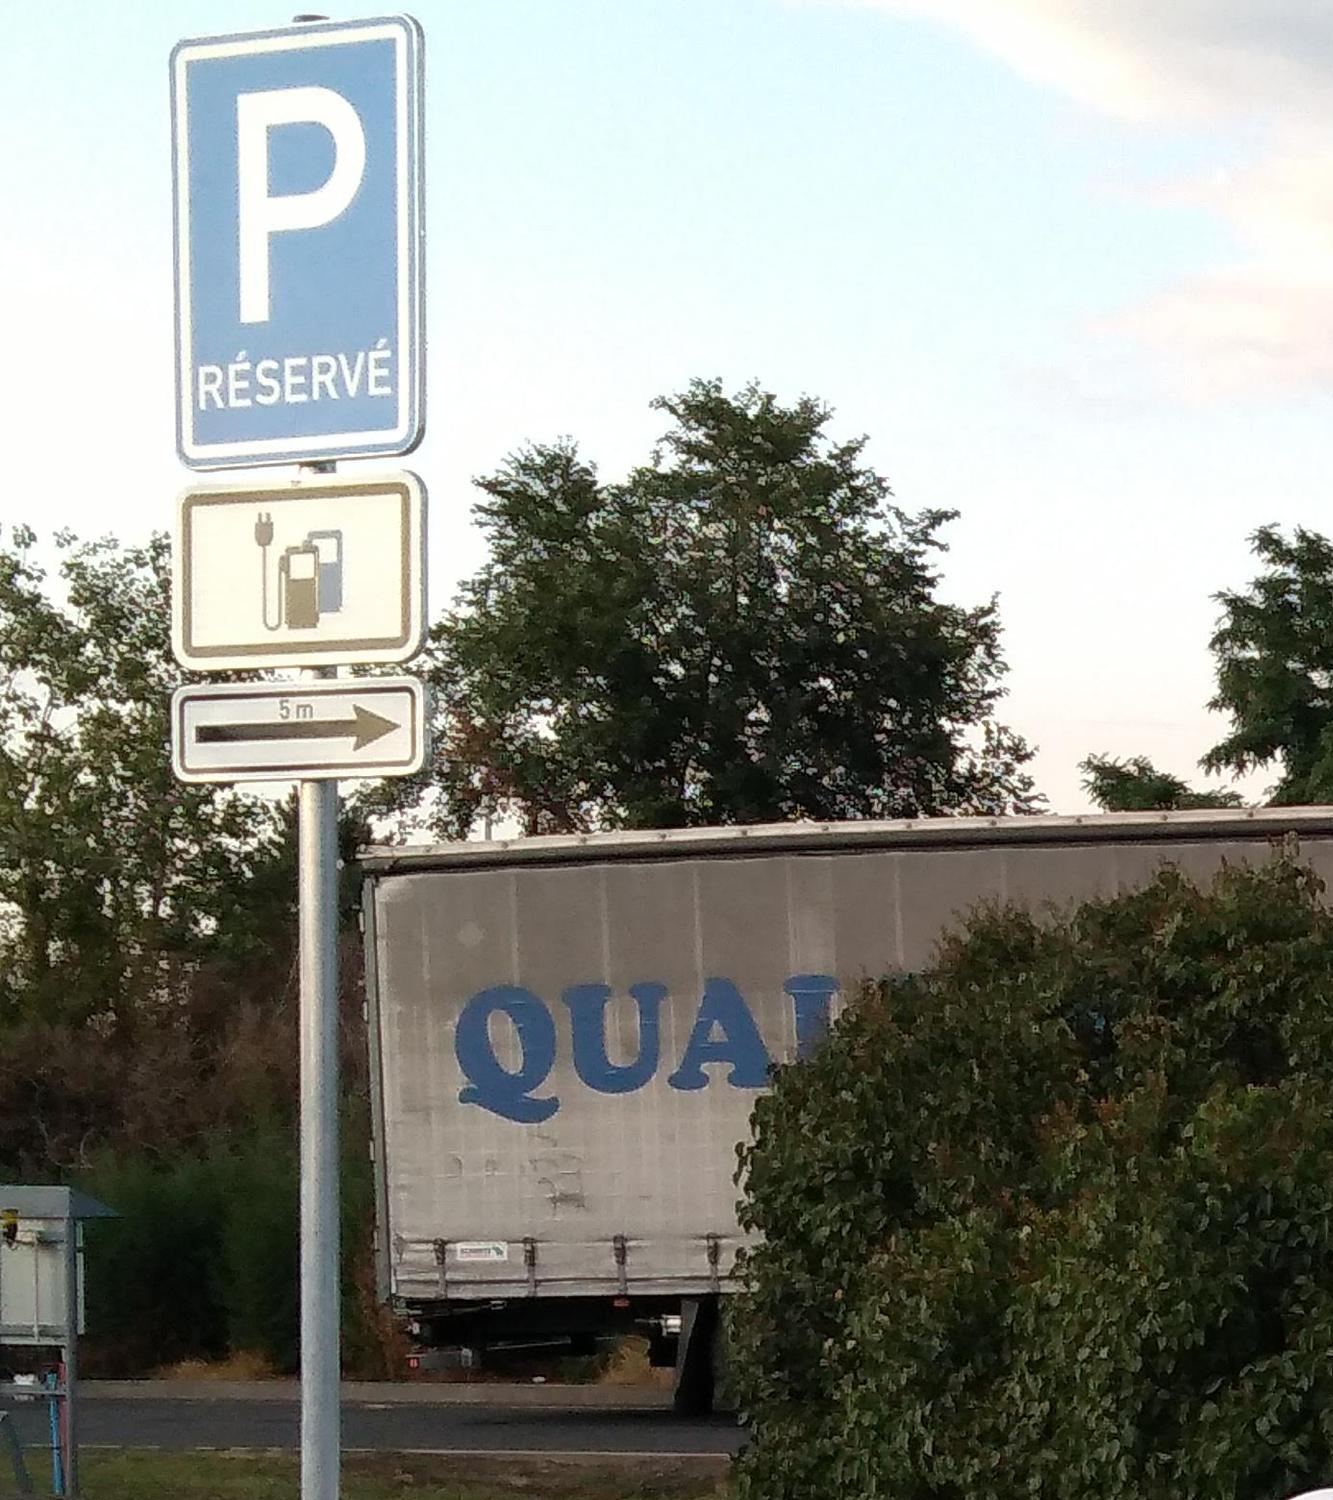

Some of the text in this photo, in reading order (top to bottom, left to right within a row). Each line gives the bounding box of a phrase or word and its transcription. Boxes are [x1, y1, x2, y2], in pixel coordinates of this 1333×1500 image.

[237, 86, 366, 324] P
[199, 339, 393, 411] RÉSERVÉ
[279, 699, 314, 720] 5 m
